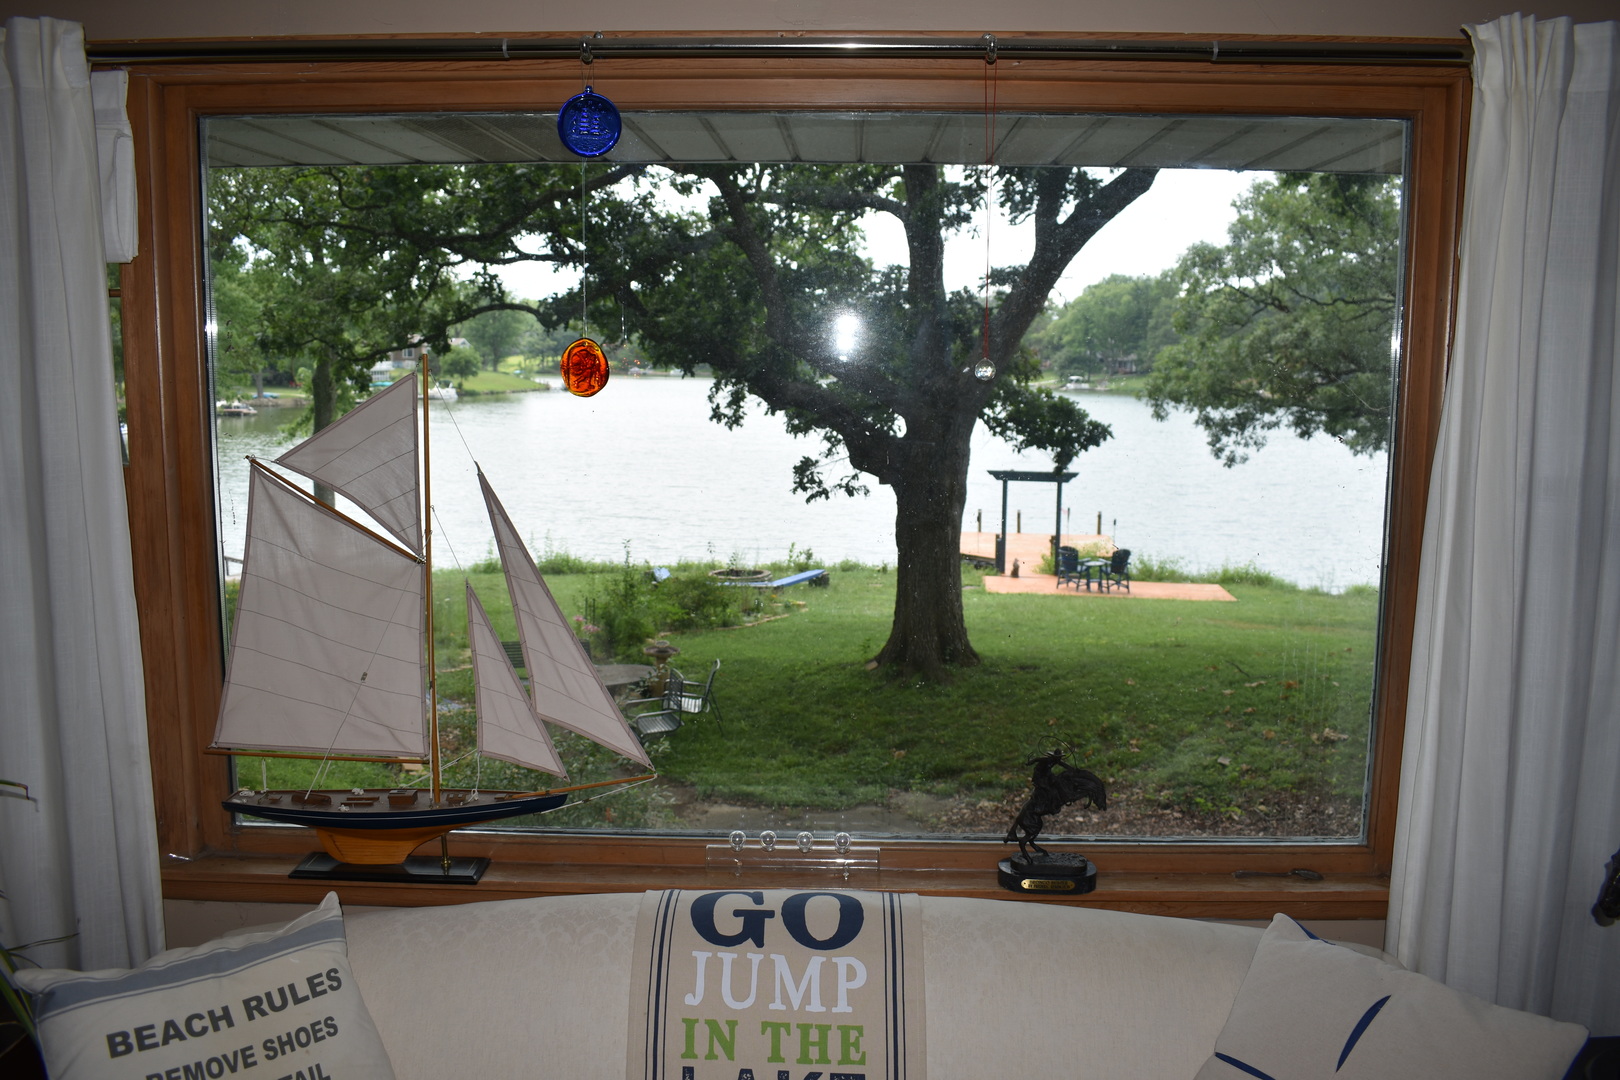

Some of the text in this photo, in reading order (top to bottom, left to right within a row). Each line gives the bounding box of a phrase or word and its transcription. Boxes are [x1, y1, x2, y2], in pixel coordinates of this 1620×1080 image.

[690, 891, 864, 951] GO
[684, 951, 868, 1013] JUMP
[106, 967, 342, 1058] BEACH RULES
[262, 1016, 339, 1060] SHOES
[680, 1018, 866, 1066] IN THE
